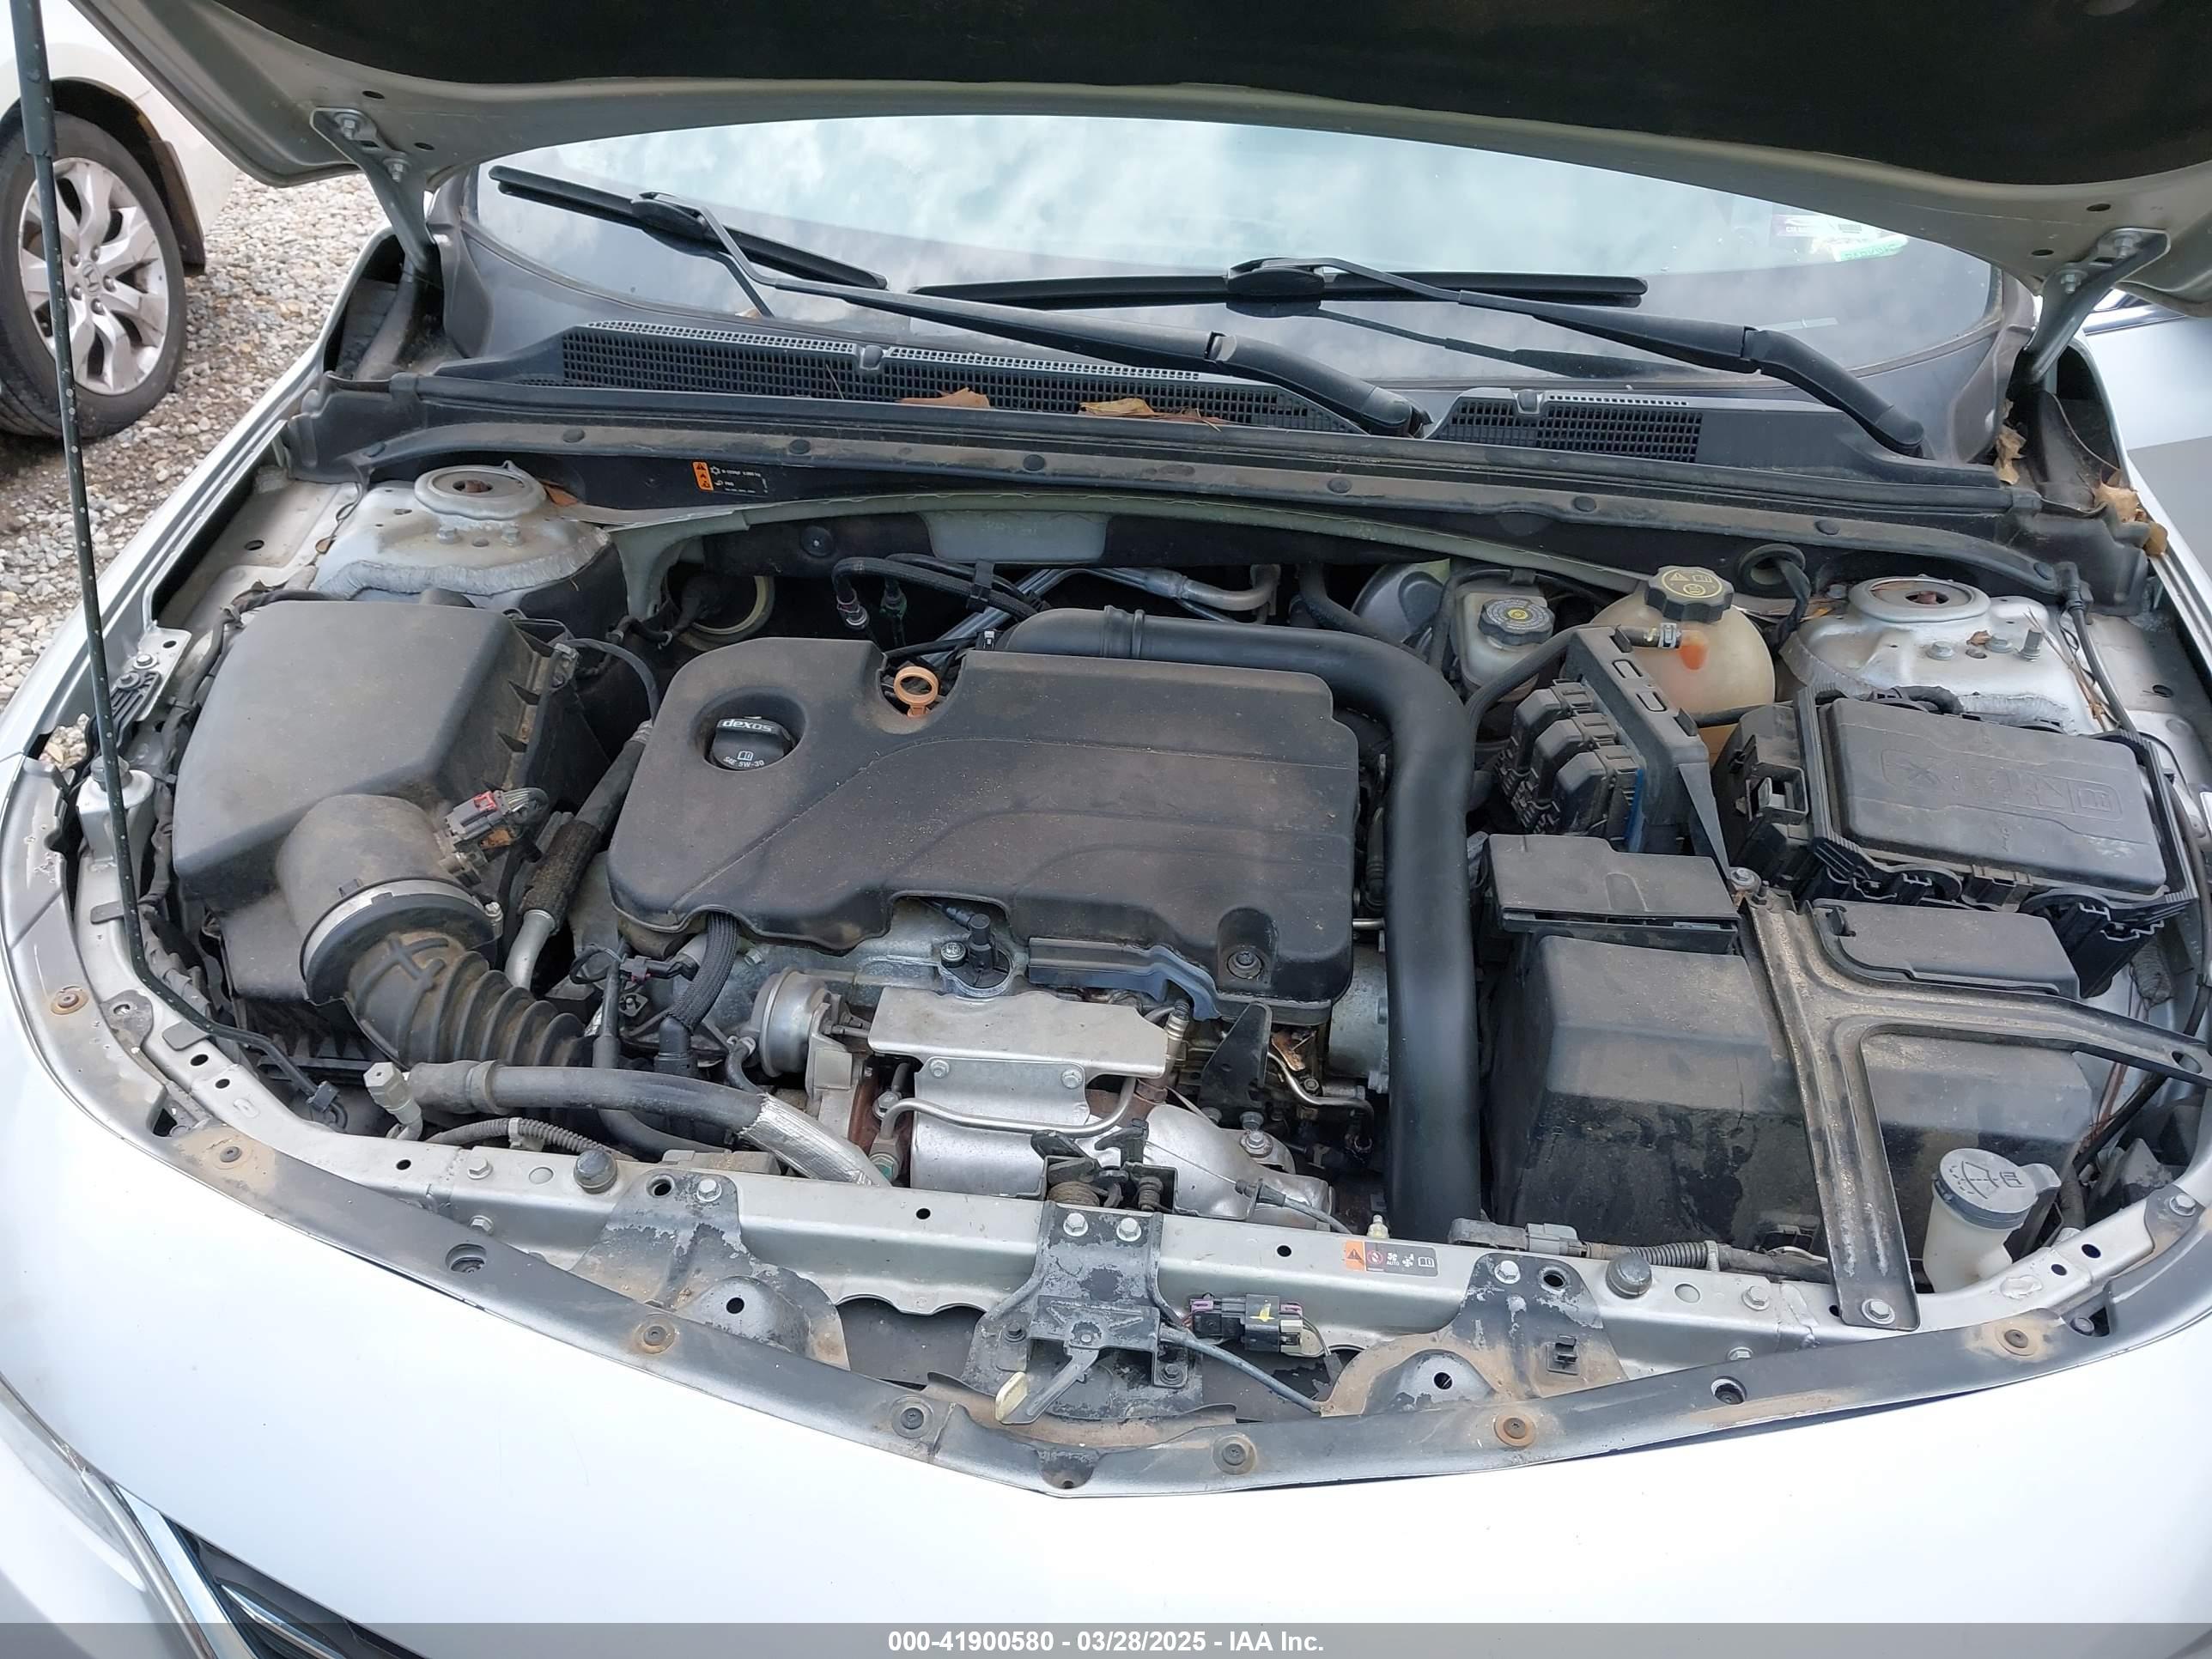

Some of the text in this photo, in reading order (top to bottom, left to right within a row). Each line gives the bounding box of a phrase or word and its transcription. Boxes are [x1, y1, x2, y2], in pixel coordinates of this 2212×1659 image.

[722, 719, 774, 732] dexos
[723, 757, 764, 768] SAE 5W-30
